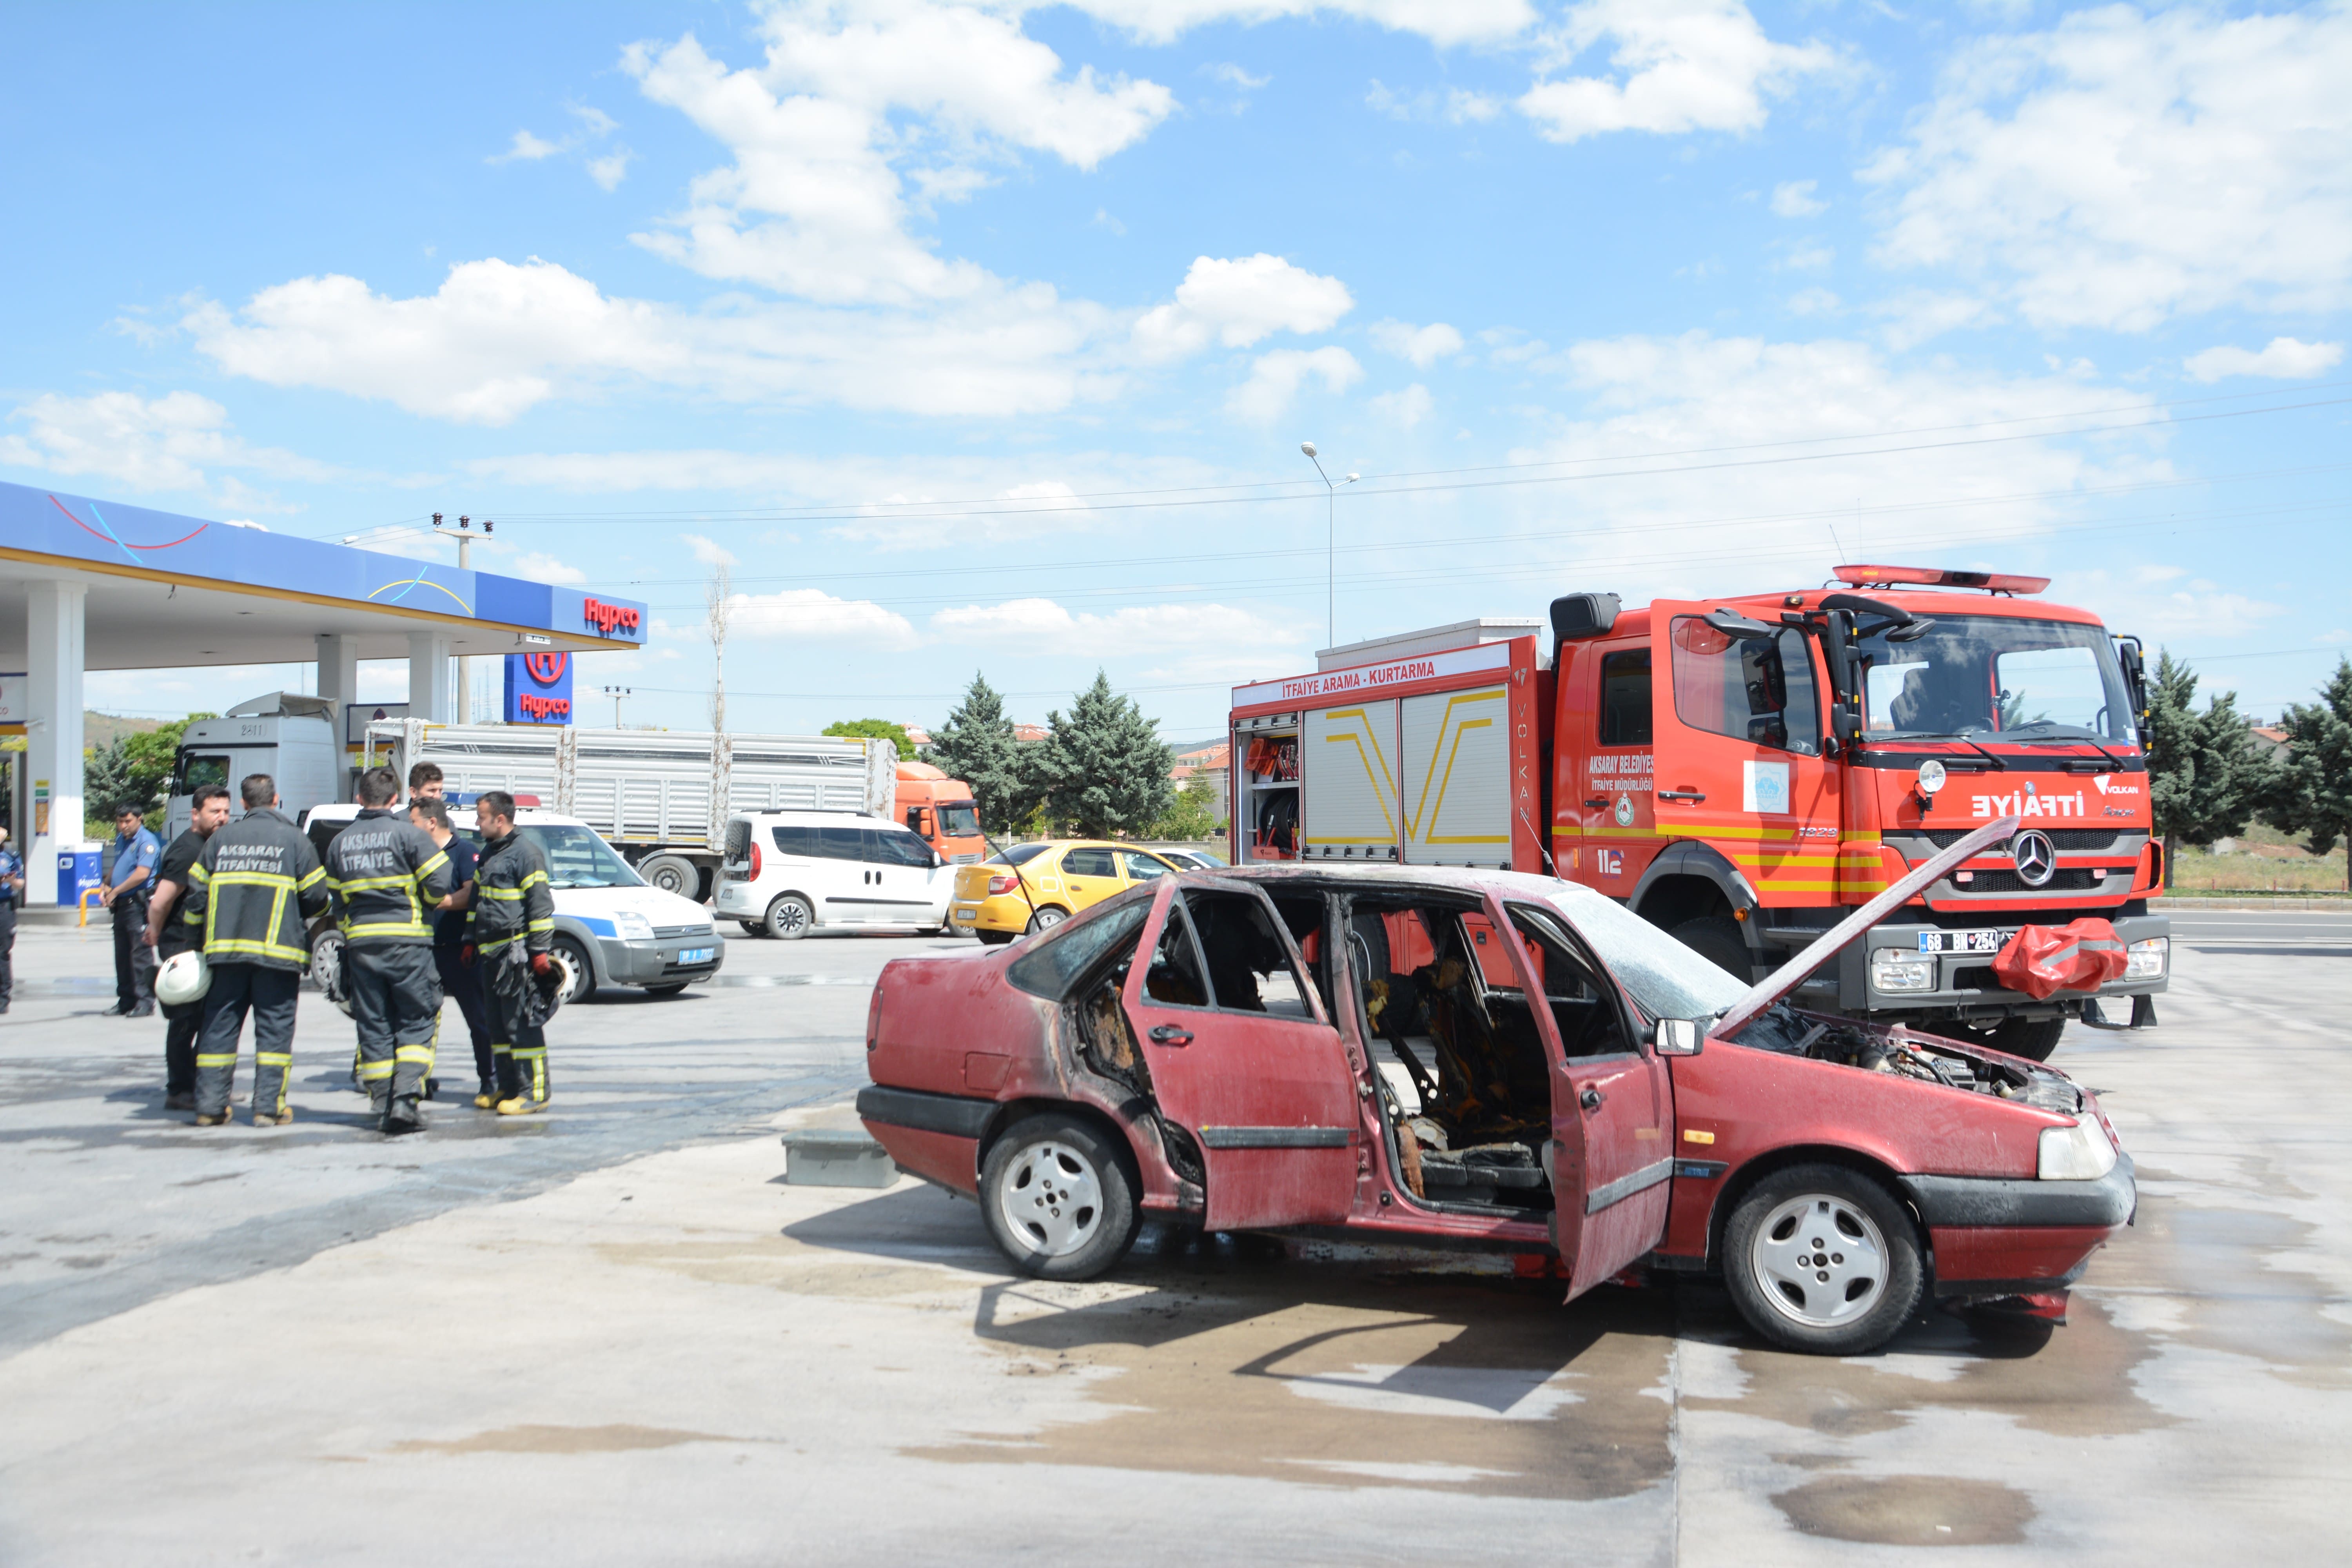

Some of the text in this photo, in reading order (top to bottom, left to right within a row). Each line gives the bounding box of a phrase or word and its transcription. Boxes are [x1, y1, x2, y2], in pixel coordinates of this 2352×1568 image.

[584, 597, 640, 632] Hypco
[1283, 679, 1319, 698] İTFAİYE
[1323, 673, 1360, 692] ARAMA
[1369, 661, 1435, 684] KURTARMA
[520, 693, 570, 718] Hypco
[1517, 703, 1529, 819] VOLKAN
[1589, 755, 1619, 774] AKSARAY
[1592, 777, 1653, 791] İTFAİYE MÜDÜRLÜĞÜ
[2107, 786, 2139, 794] VOLKAN
[340, 831, 392, 852] AKSARAY
[1798, 827, 1838, 838] 1829
[217, 845, 285, 858] AKSARAY
[341, 850, 394, 872] İTFAİYE
[1597, 849, 1622, 874] 112
[216, 857, 282, 874] İTFAİYESİ
[1927, 934, 1942, 951] 68
[1953, 933, 1968, 950] BN
[1975, 933, 1995, 950] 254
